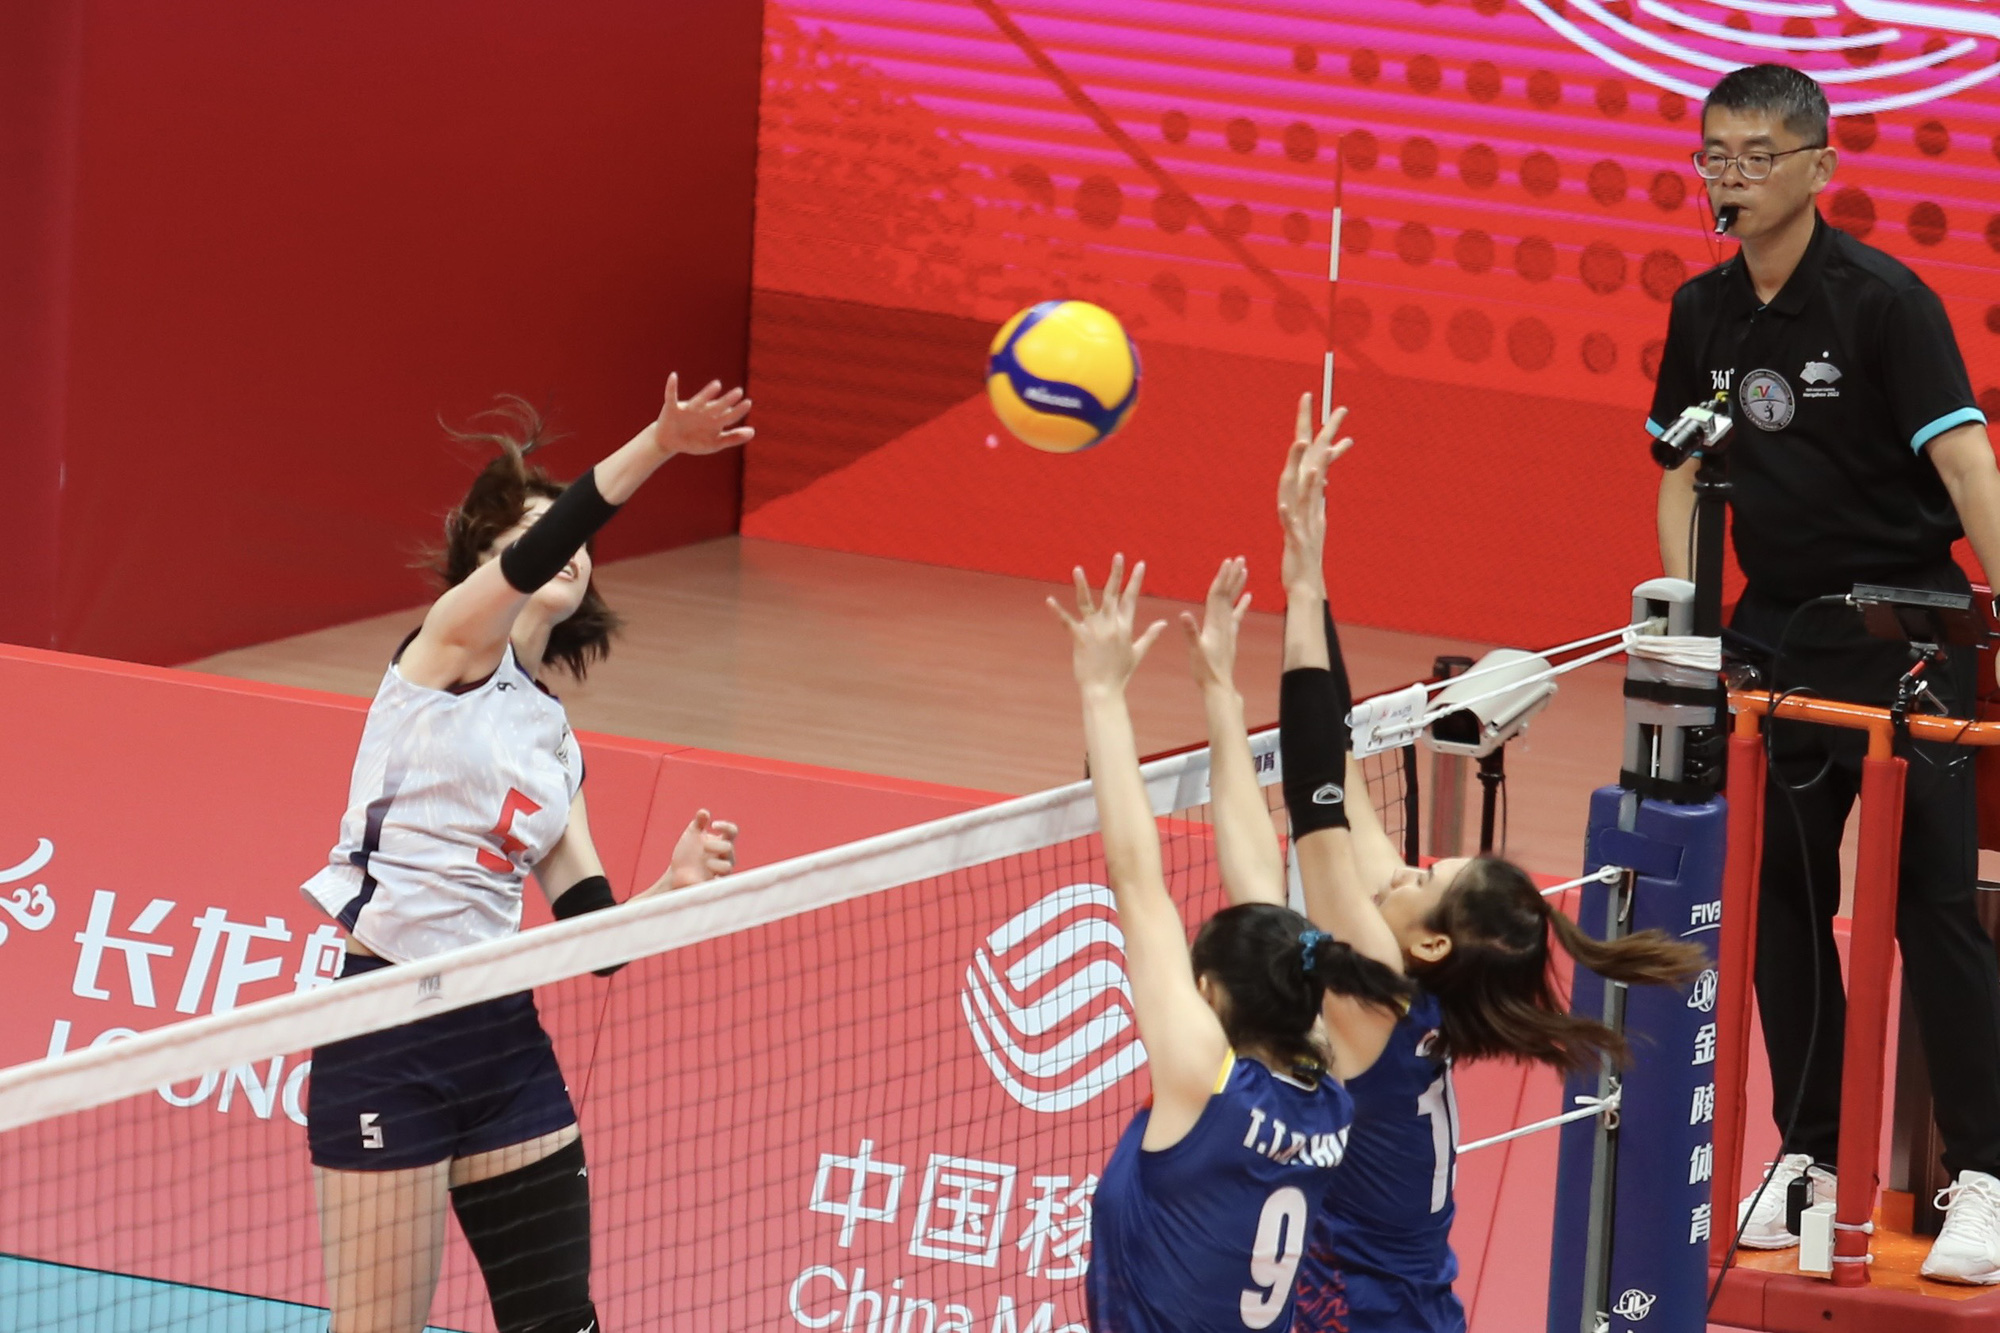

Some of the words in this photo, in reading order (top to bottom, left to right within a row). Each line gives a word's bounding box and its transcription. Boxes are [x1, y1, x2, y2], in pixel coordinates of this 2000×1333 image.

[475, 786, 543, 874] 5
[1690, 900, 1721, 926] FIVB
[360, 1113, 384, 1149] 5
[1688, 1022, 1717, 1245] 金陵体育
[1240, 1186, 1308, 1330] 9
